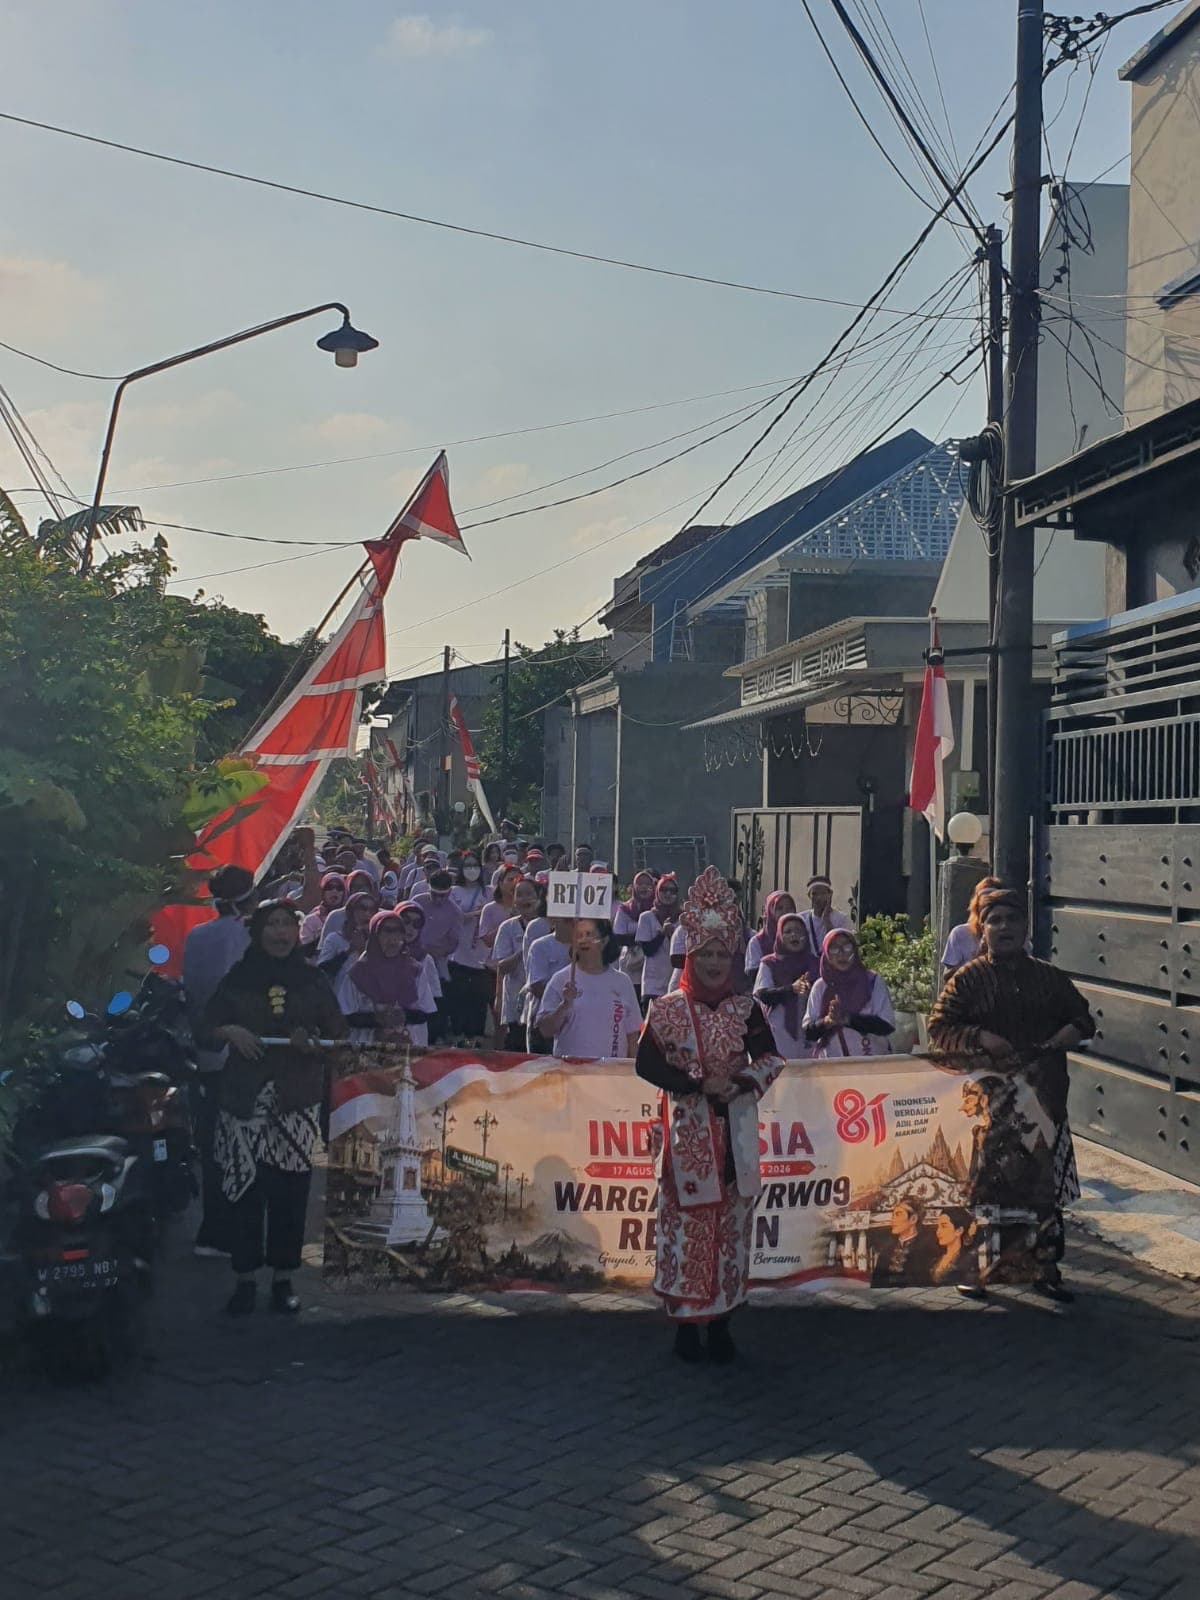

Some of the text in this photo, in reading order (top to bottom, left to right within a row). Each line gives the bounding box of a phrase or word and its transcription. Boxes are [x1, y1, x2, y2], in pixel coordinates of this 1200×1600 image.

[552, 883, 608, 905] RT 07
[893, 1096, 936, 1107] INDONESIA
[833, 1088, 890, 1147] 81
[894, 1107, 938, 1118] BERDAULAT
[895, 1119, 912, 1128] ADIL
[613, 1166, 622, 1175] 17
[767, 1164, 791, 1174] 2026
[752, 1252, 801, 1265] Bersama
[38, 1269, 47, 1281] W
